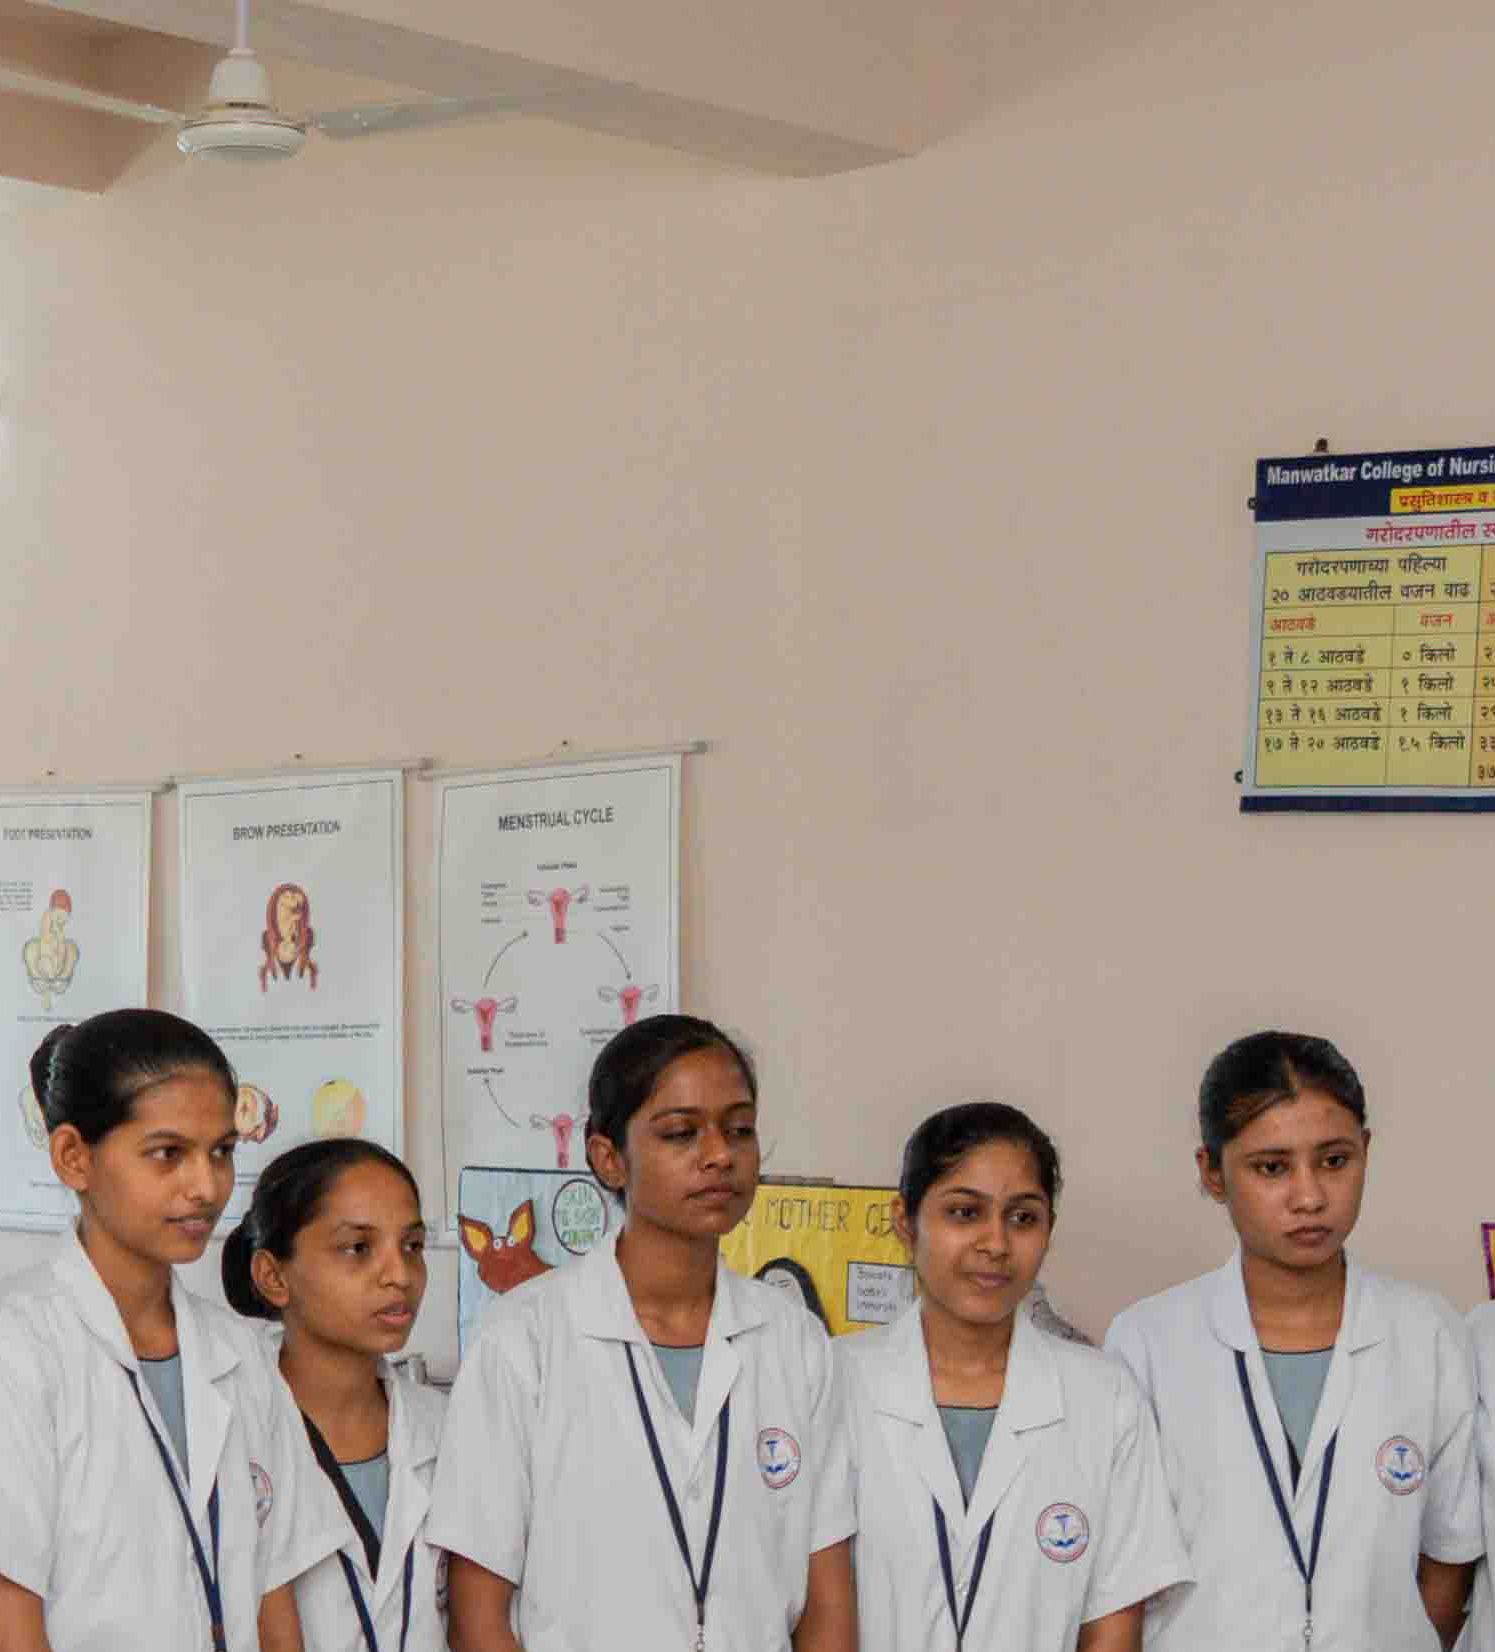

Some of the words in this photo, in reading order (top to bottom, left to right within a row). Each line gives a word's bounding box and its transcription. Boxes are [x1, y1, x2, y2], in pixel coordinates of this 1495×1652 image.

[1267, 463, 1357, 485] Manwatkar
[1361, 458, 1422, 482] College
[1427, 457, 1444, 476] of
[1366, 518, 1476, 542] गरोदरपणातील
[1319, 645, 1365, 665] आठवडे
[1420, 643, 1455, 662] किलो
[1327, 673, 1373, 692] आठवडे
[1418, 672, 1454, 691] किलो
[1336, 703, 1381, 721] आठवडे
[1418, 701, 1452, 720] किलो
[1334, 731, 1380, 751] आठवडे
[1429, 731, 1465, 751] किलो
[499, 810, 569, 832] MENSTRUAL
[575, 806, 613, 826] CYCLE
[28, 827, 93, 840] PRESENTATION
[267, 819, 340, 840] PRESENTATION
[766, 1198, 850, 1232] MOTHER
